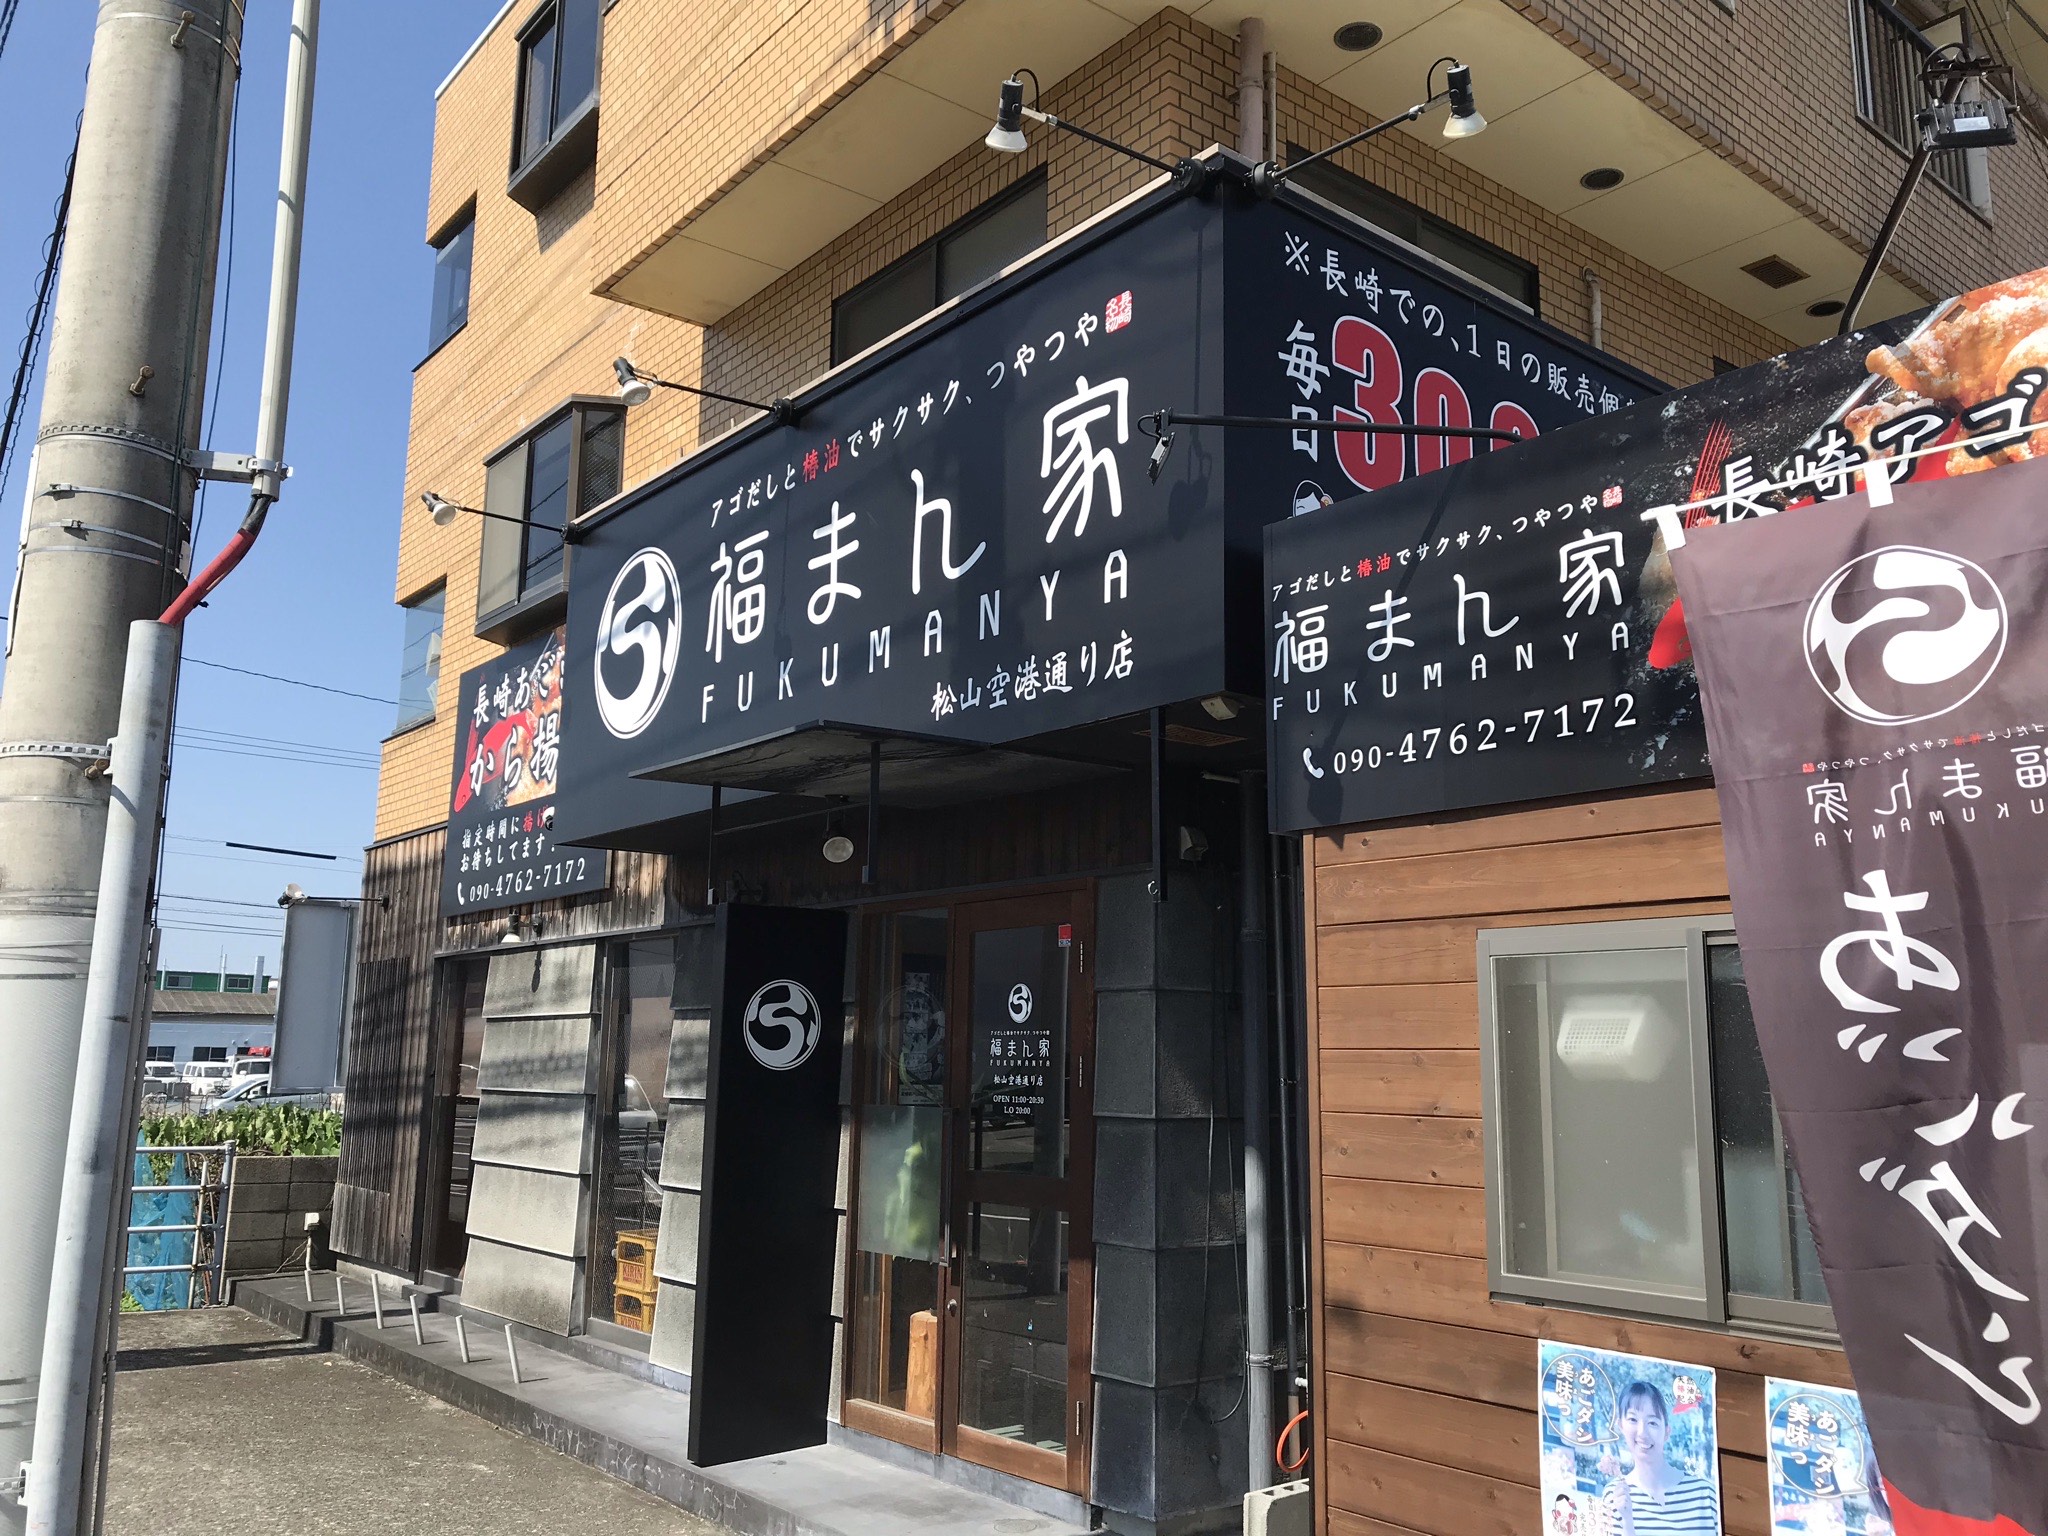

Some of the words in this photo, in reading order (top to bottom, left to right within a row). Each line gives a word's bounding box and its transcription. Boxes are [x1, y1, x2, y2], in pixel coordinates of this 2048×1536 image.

[1285, 231, 1635, 416] ※長崎での、1日の販売個
[1278, 319, 1330, 463] 毎日
[705, 373, 1130, 663] 福まん家
[702, 548, 1129, 725] FUKUMANYA
[1273, 529, 1625, 684] 福まん家
[474, 652, 565, 729] 長崎あご
[931, 629, 1135, 722] 松山空港通り店
[1273, 622, 1630, 721] FUKUMANYA
[1333, 692, 1637, 775] 090-4762-7172
[470, 857, 586, 902] 090-4762-7172
[990, 1037, 1050, 1058] 福まん家
[990, 1059, 1050, 1067] FUKUMANYA
[993, 1073, 1044, 1087] 松山空港通り店
[993, 1095, 1010, 1103] OPEN
[1015, 1107, 1031, 1115] 20:00
[1555, 1361, 1575, 1416] 美味っ
[1577, 1368, 1596, 1442] あごダシ
[1786, 1401, 1811, 1465] 美味っ
[1814, 1410, 1839, 1495] あごダシ
